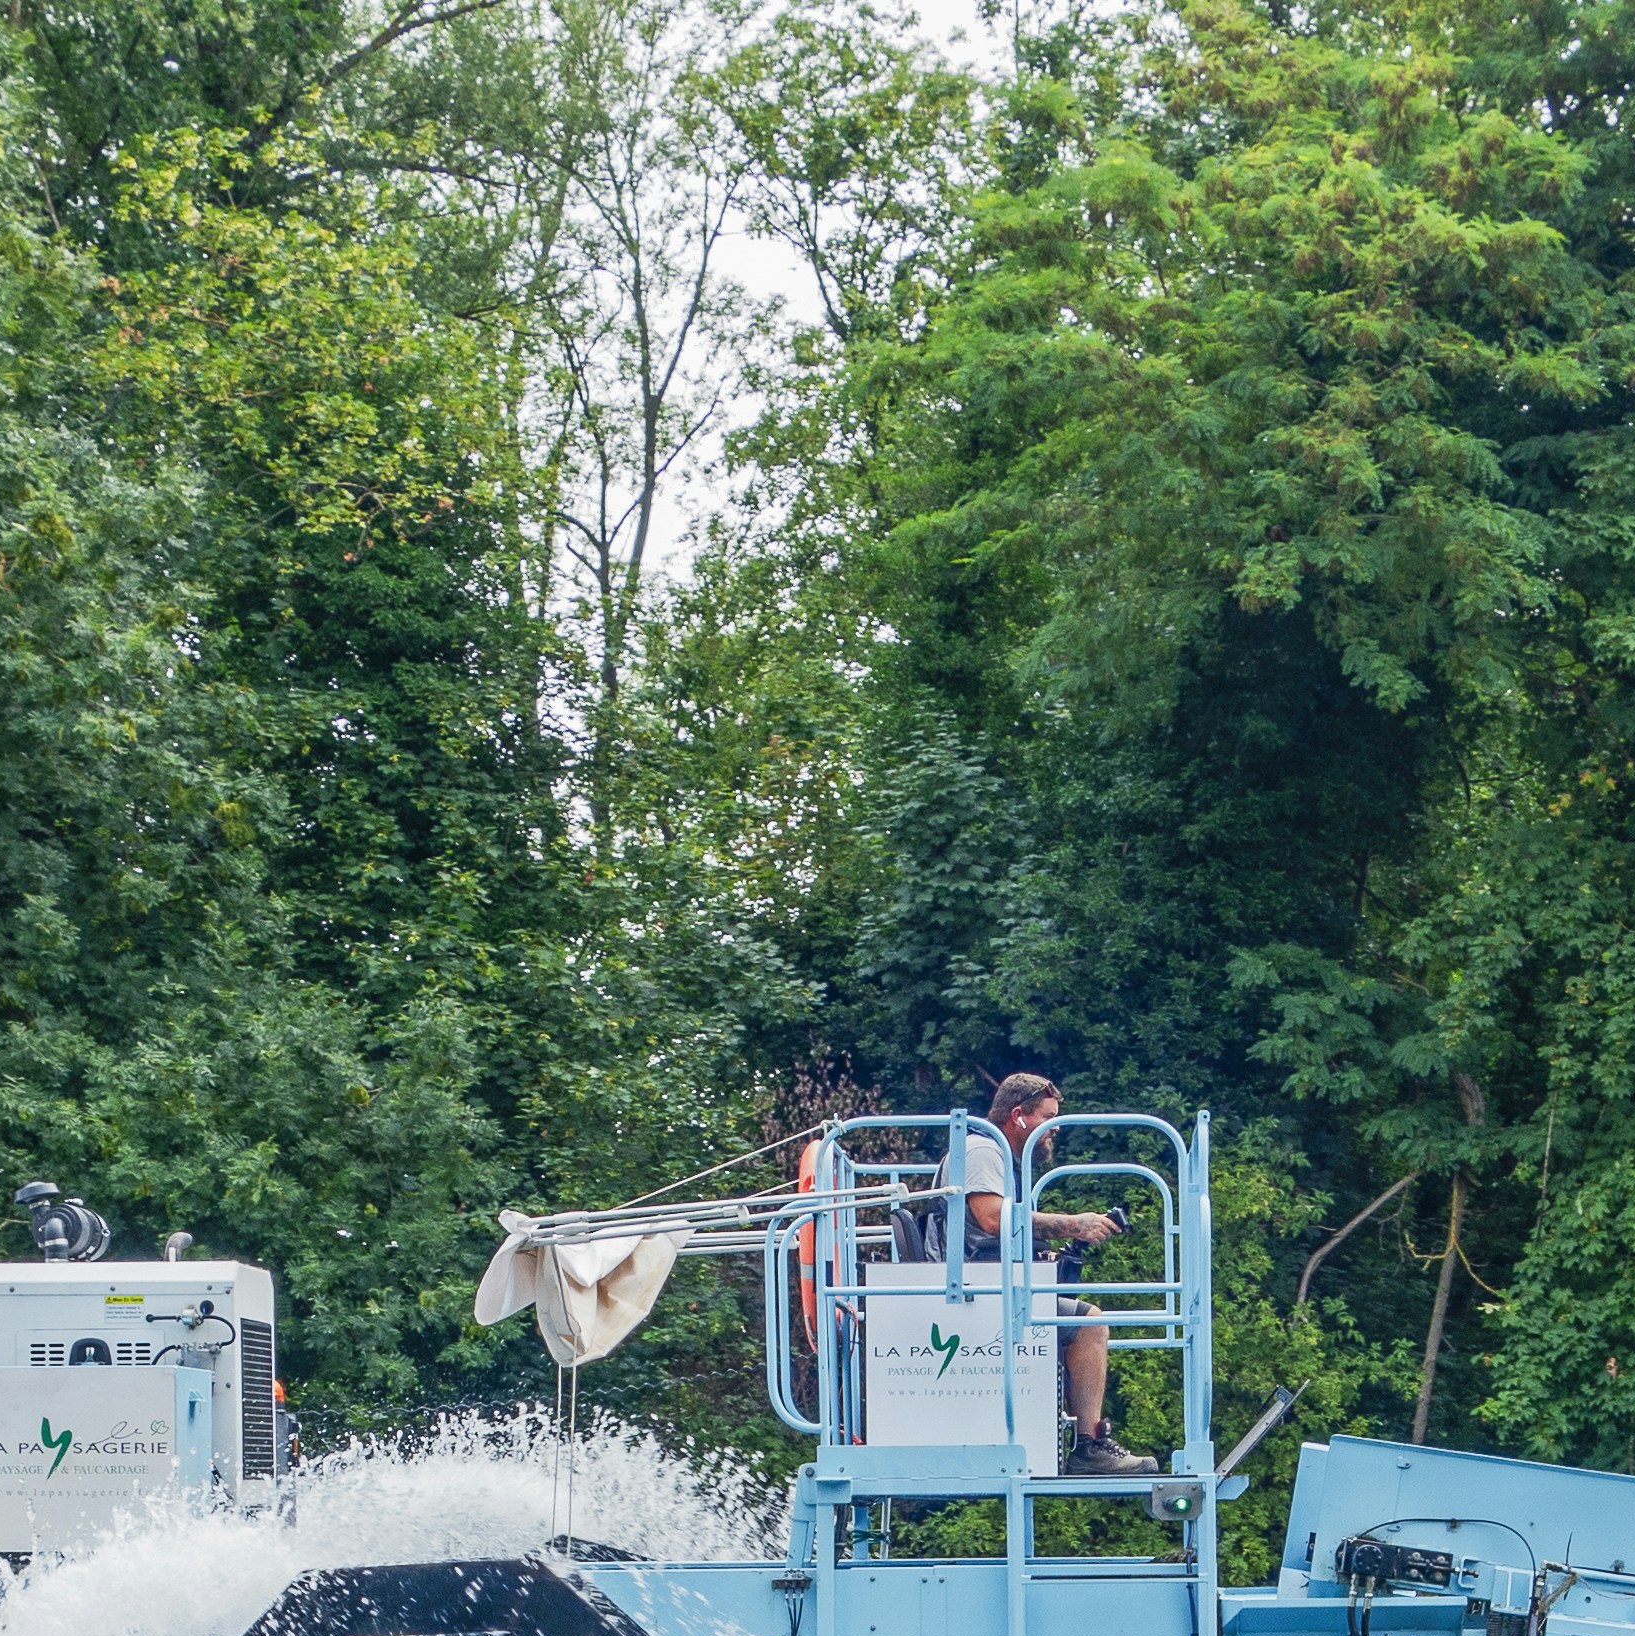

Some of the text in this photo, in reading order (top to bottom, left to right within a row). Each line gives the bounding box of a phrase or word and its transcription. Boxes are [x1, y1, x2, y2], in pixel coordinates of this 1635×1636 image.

[874, 1346, 901, 1358] LA
[887, 1366, 1031, 1376] PAYSAGE & FAUCARGE
[887, 1387, 1033, 1398] www.lapaysageri.fr
[60, 1465, 69, 1475] &
[73, 1464, 150, 1475] FAUCARDAGE
